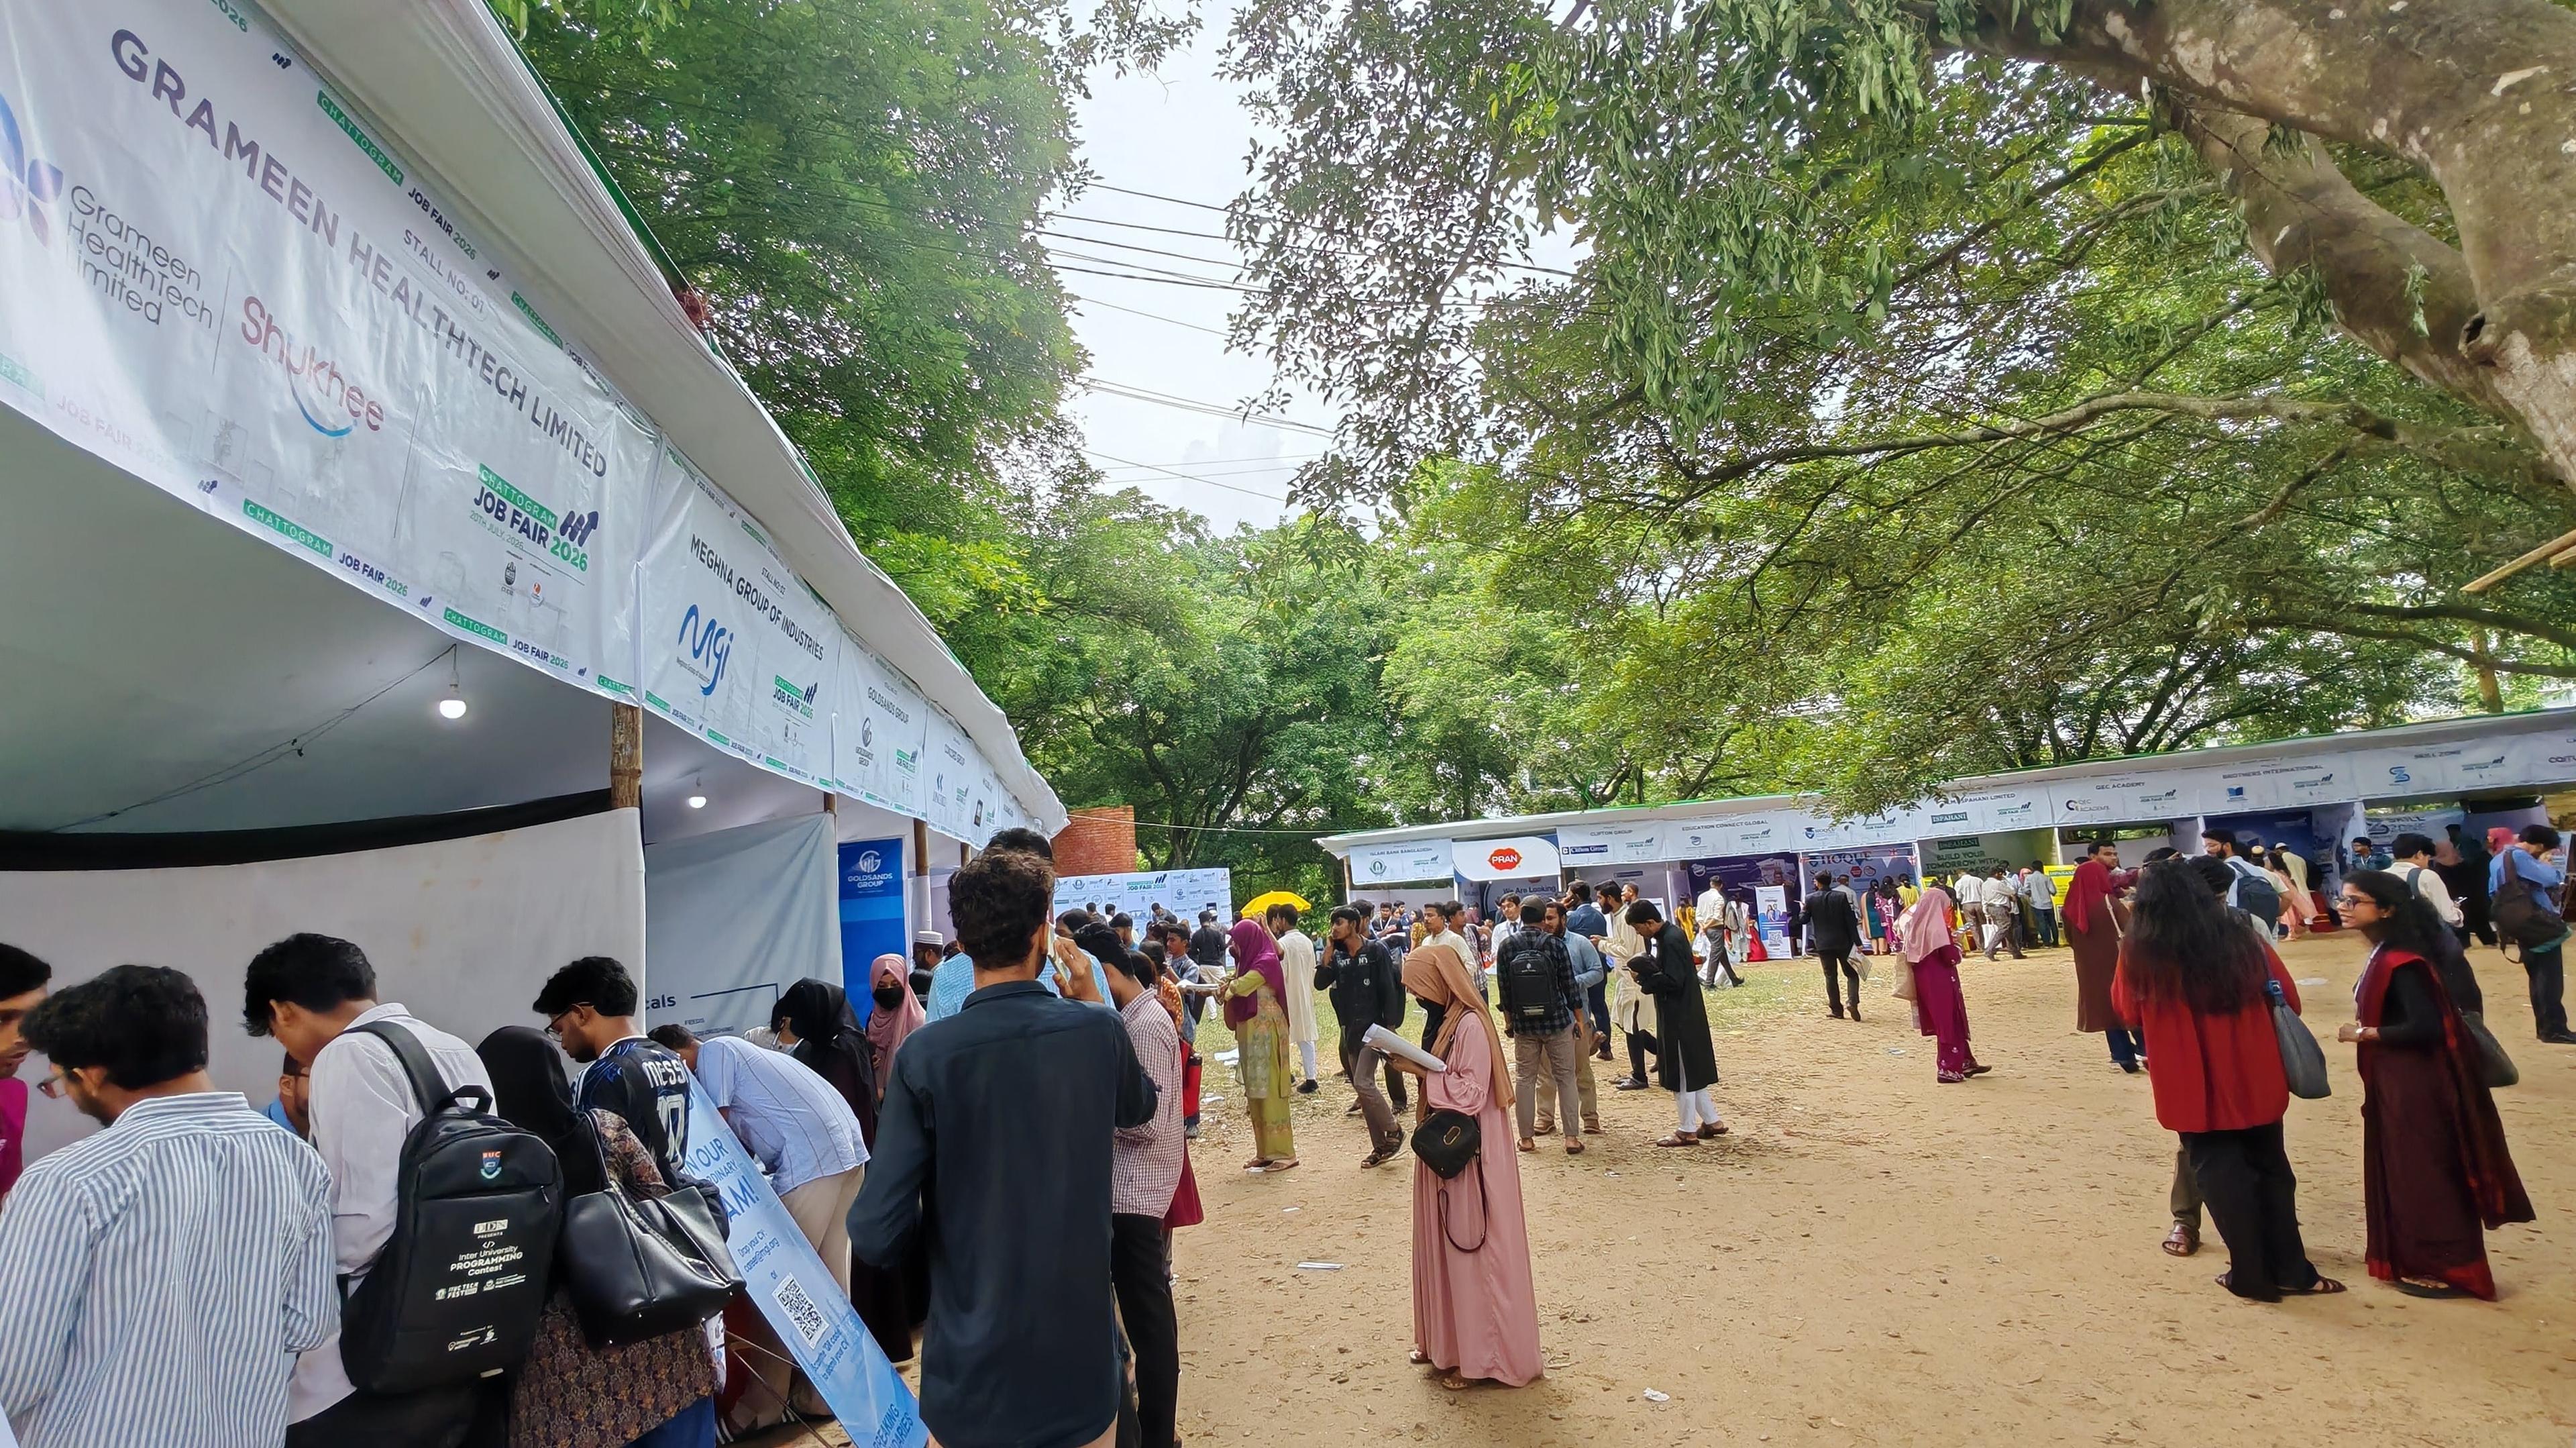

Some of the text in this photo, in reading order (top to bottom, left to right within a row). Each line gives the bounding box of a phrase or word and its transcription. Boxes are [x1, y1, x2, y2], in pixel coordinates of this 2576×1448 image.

[320, 95, 477, 261] CHATTOGRAM JOB FAIR 2026
[71, 185, 201, 292] Grameen
[111, 29, 607, 478] GRAMEEN HEALTHTECH LIMITED
[68, 211, 213, 329] HealthTech
[76, 249, 162, 325] imited
[403, 229, 484, 314] STALL NO: 01
[241, 296, 384, 431] Shukhee
[480, 468, 556, 529] CHATTOGRAM
[246, 503, 409, 597] CHATTOGRAM JOB FAIR 2026
[474, 486, 588, 572] JOB FAIR 2026
[691, 533, 734, 589] MEGHNA
[737, 576, 769, 614] GROUP
[769, 605, 782, 626] OF
[782, 615, 824, 662] INDUSTRIES
[445, 609, 569, 670] CHATTOGRAM JOB FAIR 2026
[773, 687, 786, 704] JOB
[786, 694, 800, 713] FAIR
[1933, 813, 1966, 823] ISPAHANI
[848, 873, 893, 882] GOLDSANDS
[1491, 855, 1517, 864] PRAN
[1926, 860, 1976, 870] TOMORROW
[857, 880, 884, 888] GROUP
[1529, 885, 1556, 893] Looking
[641, 1059, 690, 1089] MESSI
[696, 1138, 729, 1168] OUR
[720, 1175, 761, 1223] AM!
[450, 1251, 523, 1272] PROGRAMMING
[458, 1246, 519, 1261] Inter University
[468, 1263, 503, 1276] Contest
